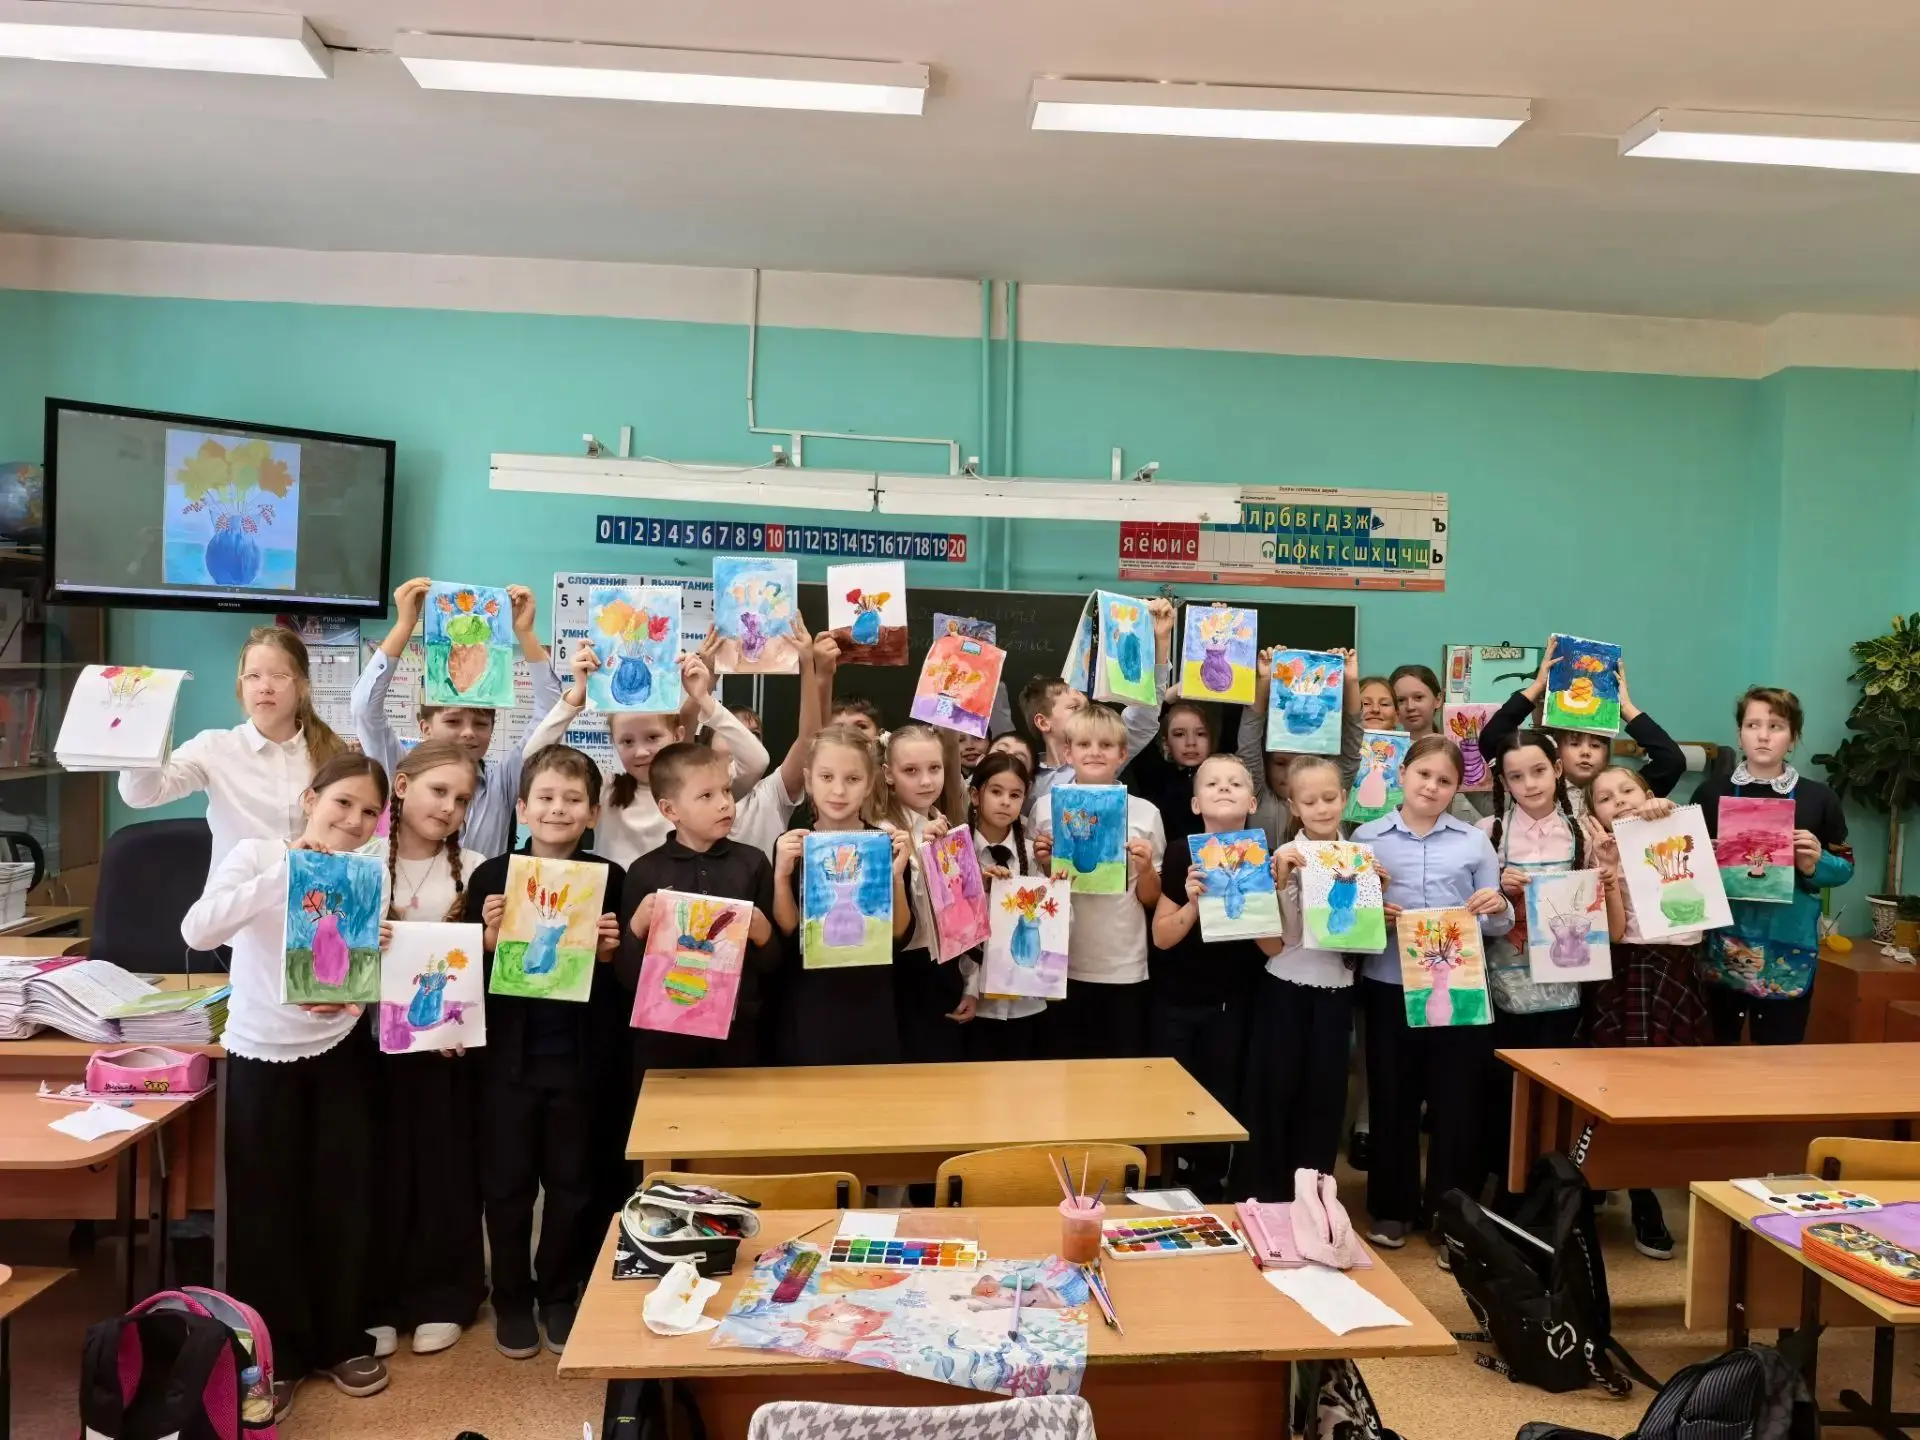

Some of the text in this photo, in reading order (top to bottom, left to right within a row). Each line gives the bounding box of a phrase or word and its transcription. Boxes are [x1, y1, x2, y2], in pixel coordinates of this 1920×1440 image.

[1264, 511, 1275, 531] р
[1280, 506, 1290, 527] б
[1296, 512, 1306, 527] в
[1313, 513, 1320, 527] г
[1326, 514, 1338, 532] д
[600, 520, 965, 557] 0 1 2 3 4 5 6 7 8 9 10 11 12 13 14 15 16 17 18 19 20
[1123, 532, 1196, 554] я ё ю и е
[1278, 544, 1288, 558] п
[1294, 539, 1306, 563] ф
[1310, 545, 1319, 559] к
[1326, 545, 1335, 559] т
[1355, 546, 1367, 560] ш
[1372, 547, 1381, 561] х
[1386, 548, 1396, 566] ц
[1402, 548, 1411, 562] ч
[1416, 549, 1428, 566] щ
[568, 576, 628, 586] СЛОЖЕНИЕ
[561, 594, 568, 607] 5
[560, 647, 566, 660] 6
